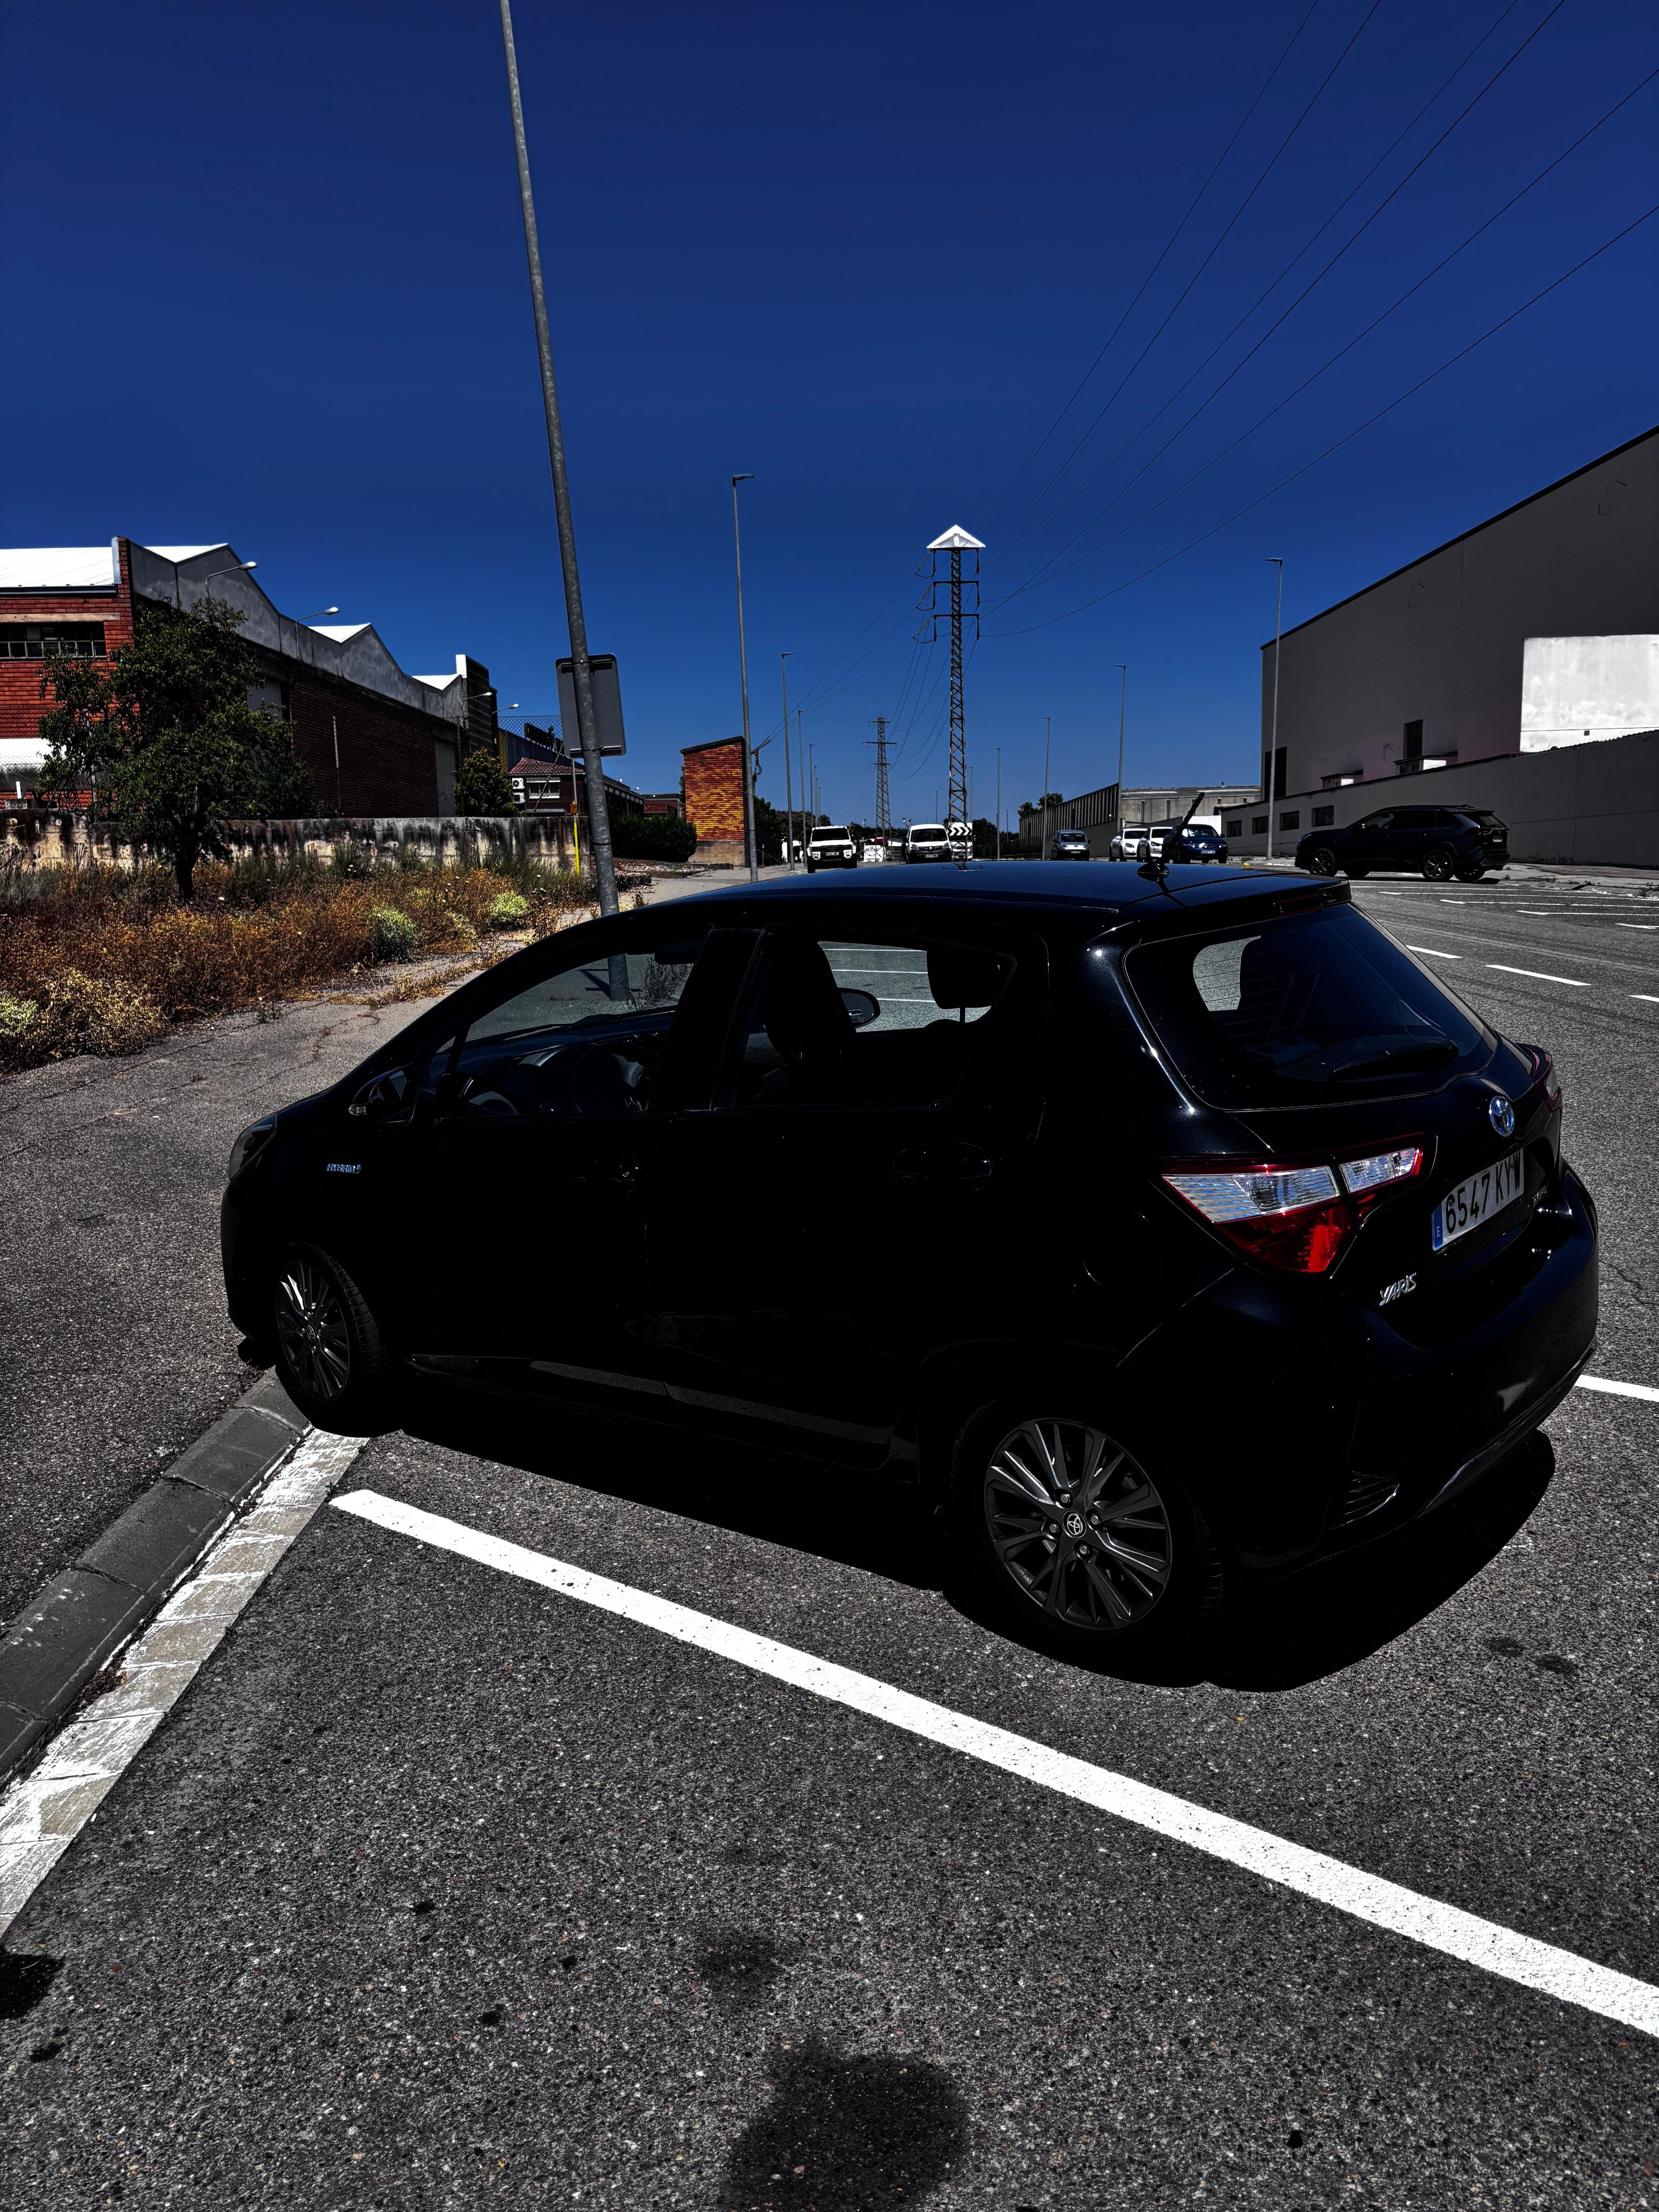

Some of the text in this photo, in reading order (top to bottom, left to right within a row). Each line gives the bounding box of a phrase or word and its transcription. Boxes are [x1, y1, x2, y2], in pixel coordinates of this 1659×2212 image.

[1446, 1150, 1520, 1233] 6547 KYW
[1437, 1222, 1440, 1237] E
[1379, 1272, 1417, 1306] YARIS
